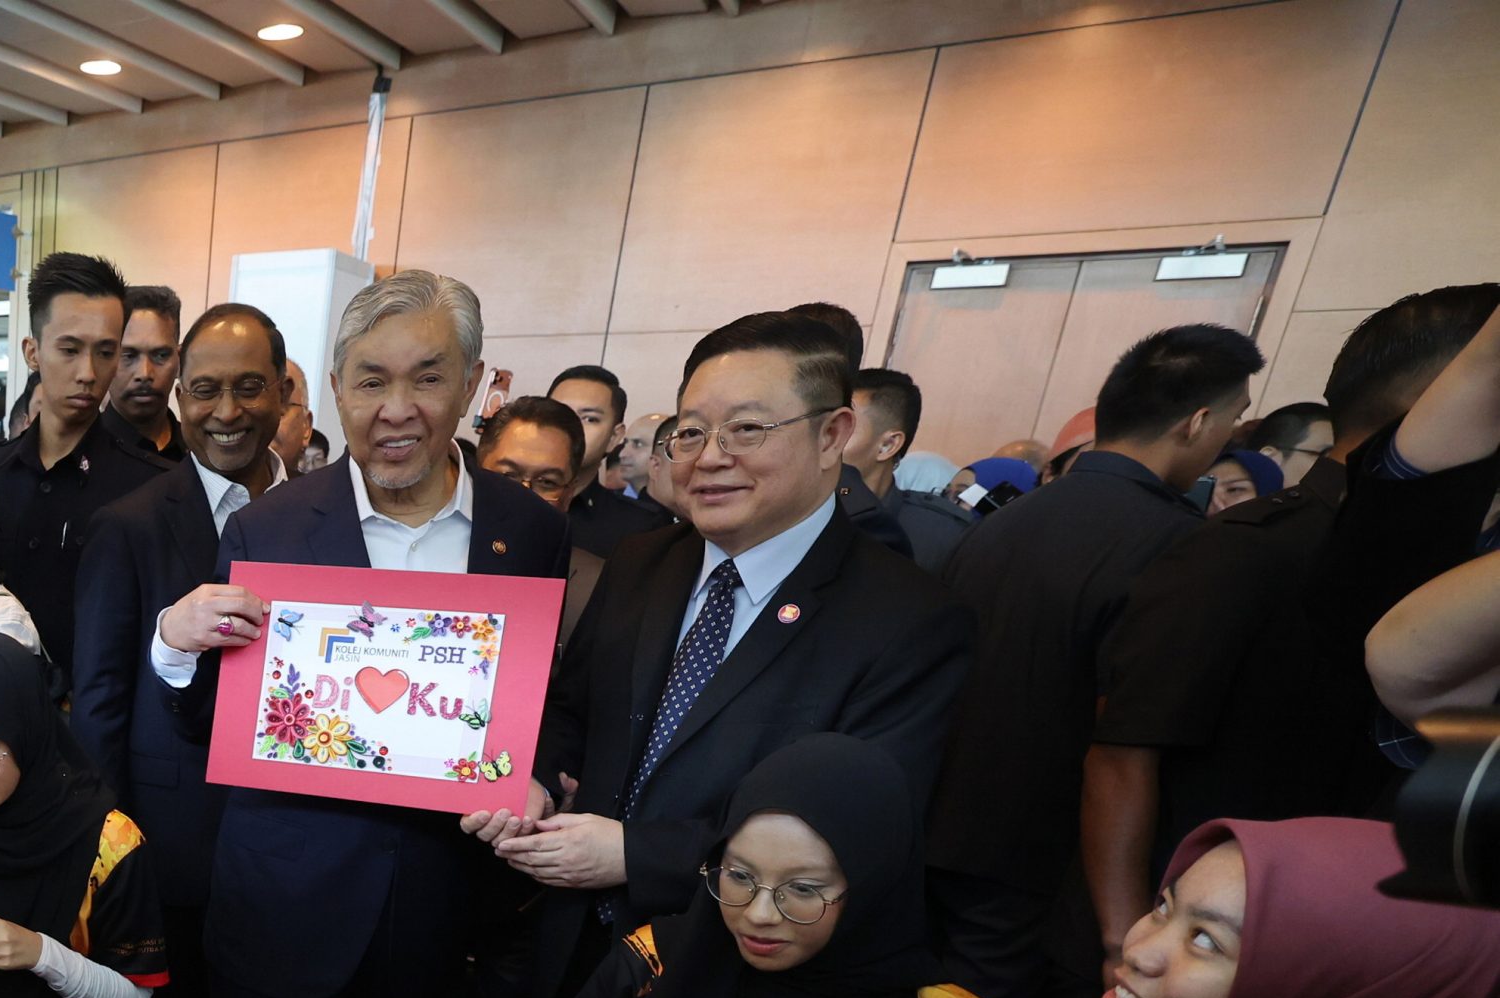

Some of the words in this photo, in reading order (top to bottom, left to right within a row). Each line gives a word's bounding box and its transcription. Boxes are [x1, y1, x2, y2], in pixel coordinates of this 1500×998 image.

[334, 653, 361, 664] JASIN
[335, 645, 362, 656] KOLEJ
[363, 647, 409, 660] KOMUNITI
[417, 644, 467, 665] PSH
[312, 673, 353, 711] Di
[406, 681, 464, 721] Ku
